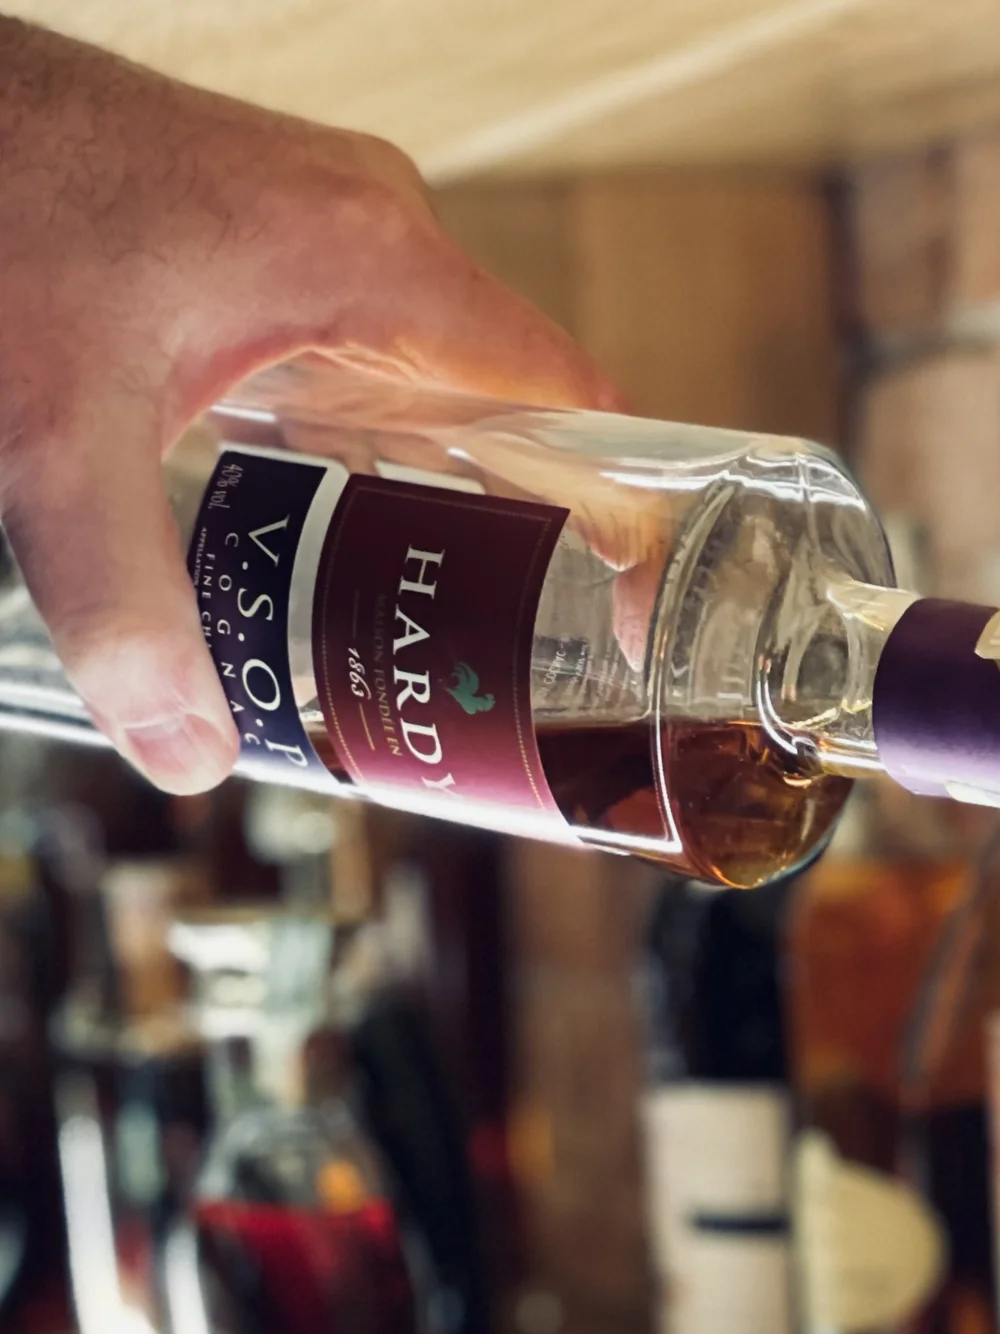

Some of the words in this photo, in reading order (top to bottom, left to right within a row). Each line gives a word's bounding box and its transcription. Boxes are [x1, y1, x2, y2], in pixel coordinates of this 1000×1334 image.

[201, 553, 216, 599] FINE
[347, 646, 372, 700] 1863
[393, 543, 465, 799] HARDY
[386, 734, 404, 757] EN
